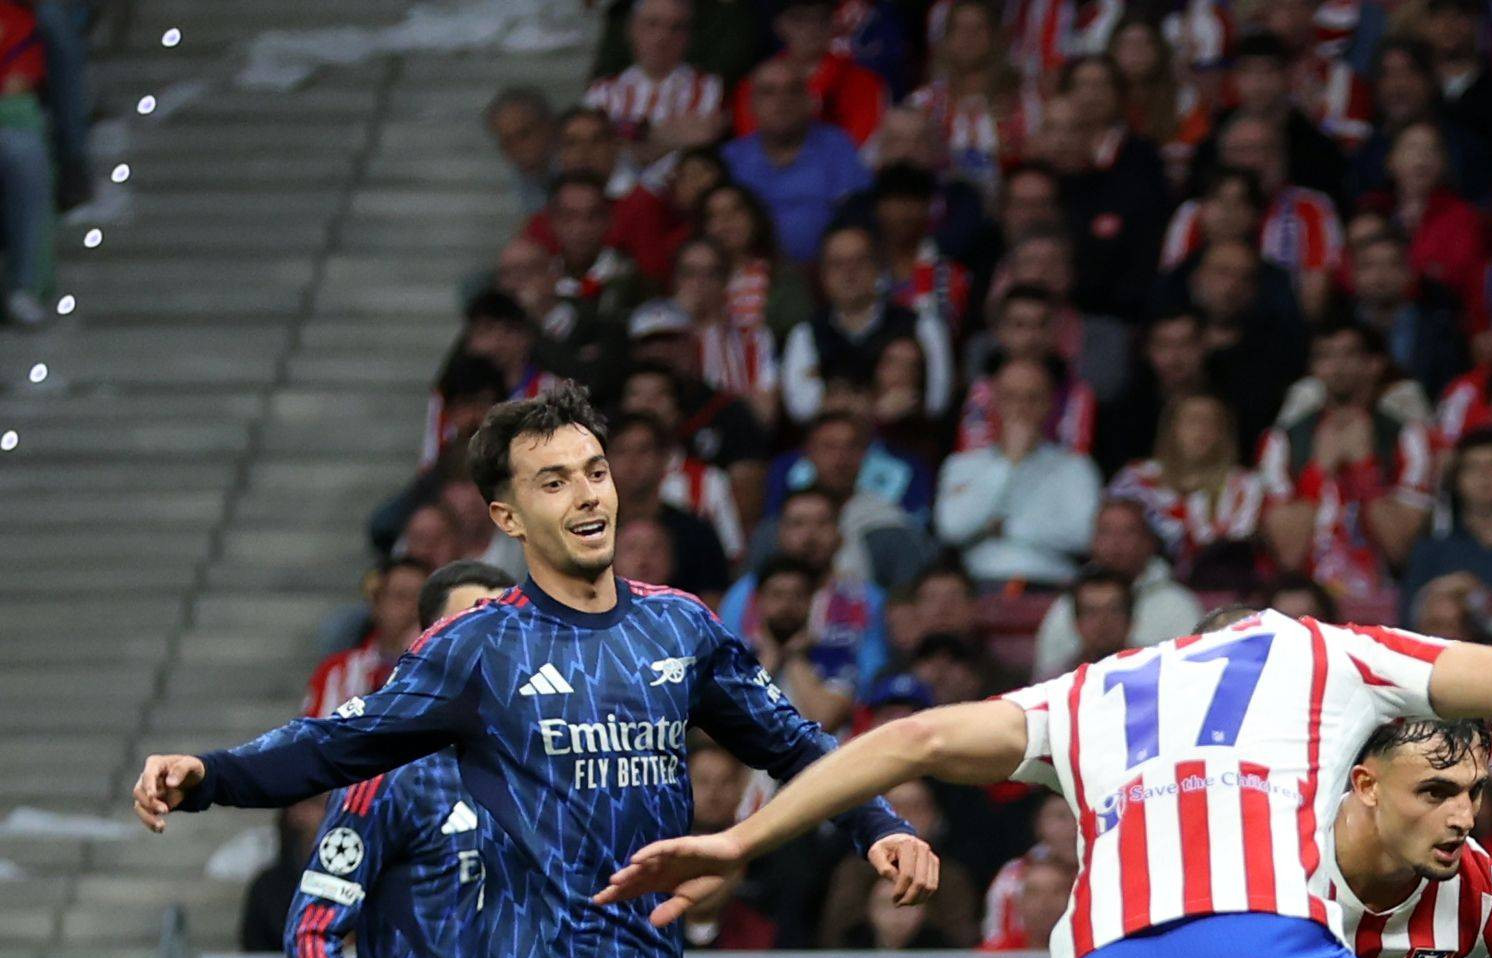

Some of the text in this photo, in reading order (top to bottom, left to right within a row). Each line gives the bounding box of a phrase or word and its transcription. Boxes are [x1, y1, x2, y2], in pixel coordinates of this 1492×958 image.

[1103, 632, 1277, 771] 17
[574, 755, 679, 790] FLY BETTER
